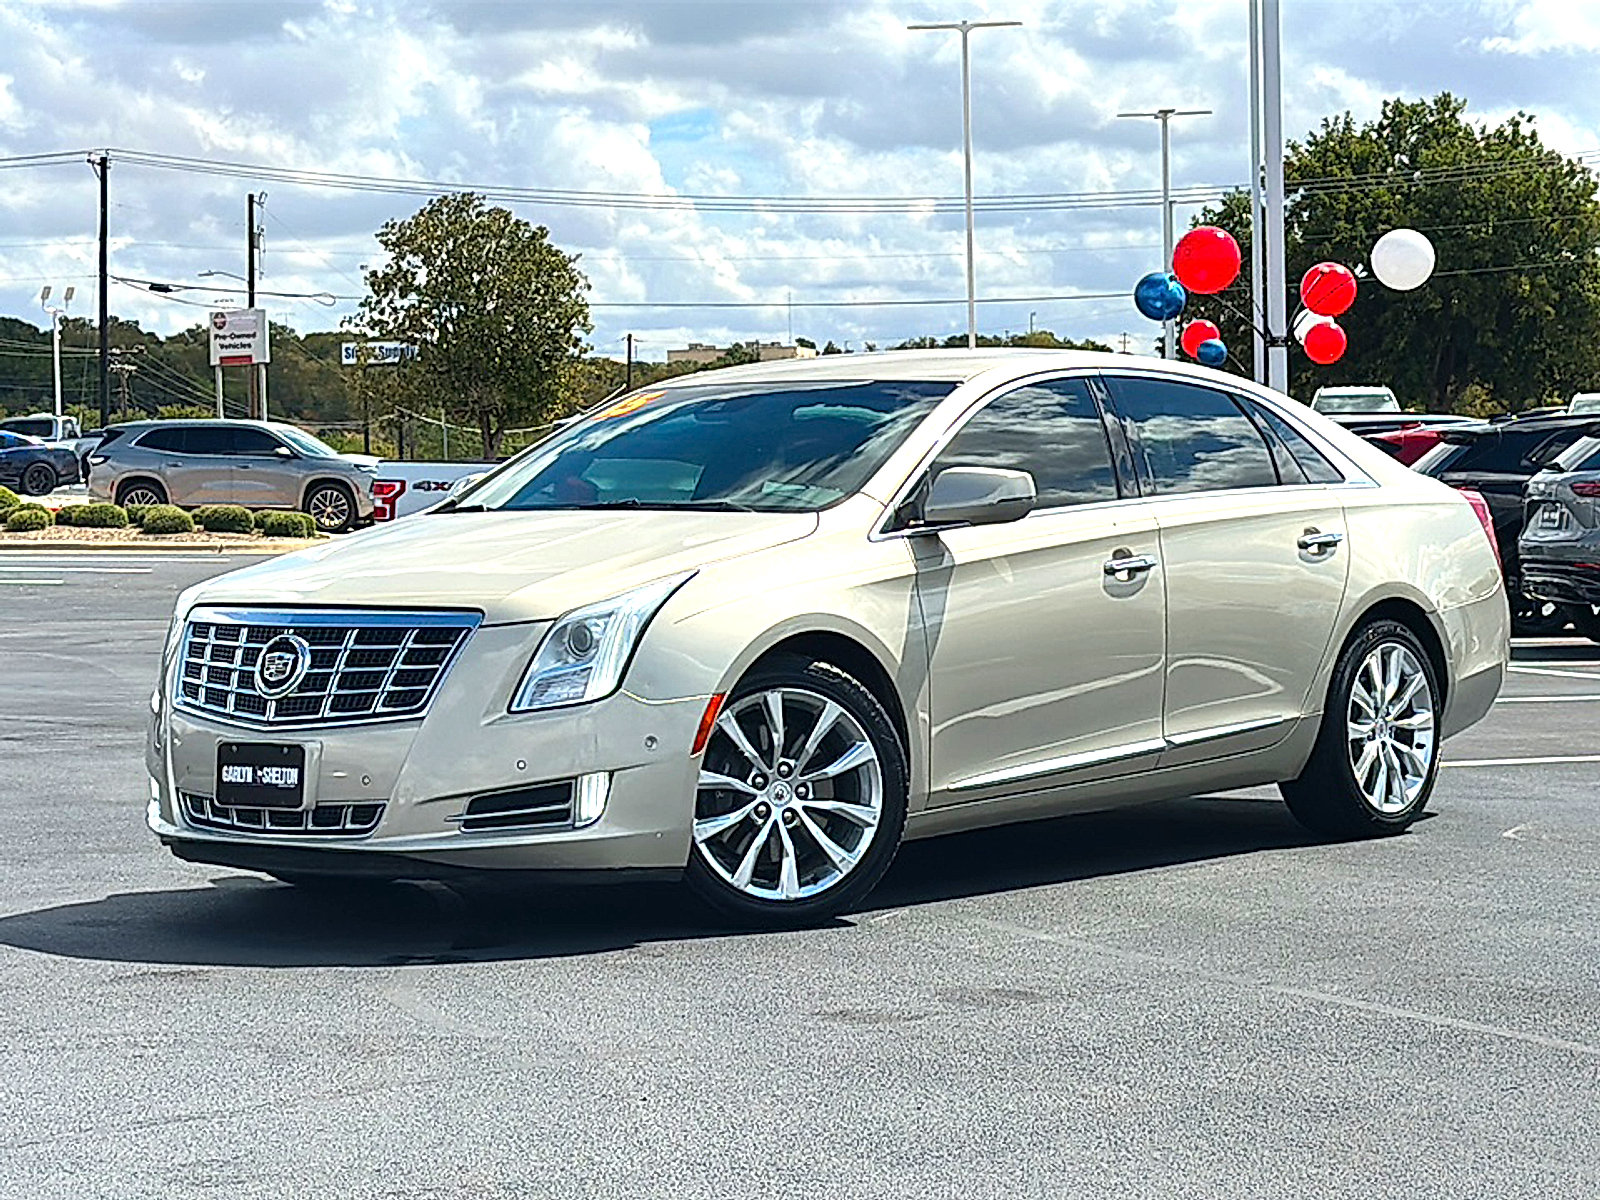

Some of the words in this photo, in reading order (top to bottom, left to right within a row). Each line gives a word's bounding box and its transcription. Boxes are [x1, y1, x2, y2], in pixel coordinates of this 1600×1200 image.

[214, 331, 256, 340] Pre-Owned
[218, 341, 252, 350] Vehicles
[262, 766, 299, 785] SHELTON
